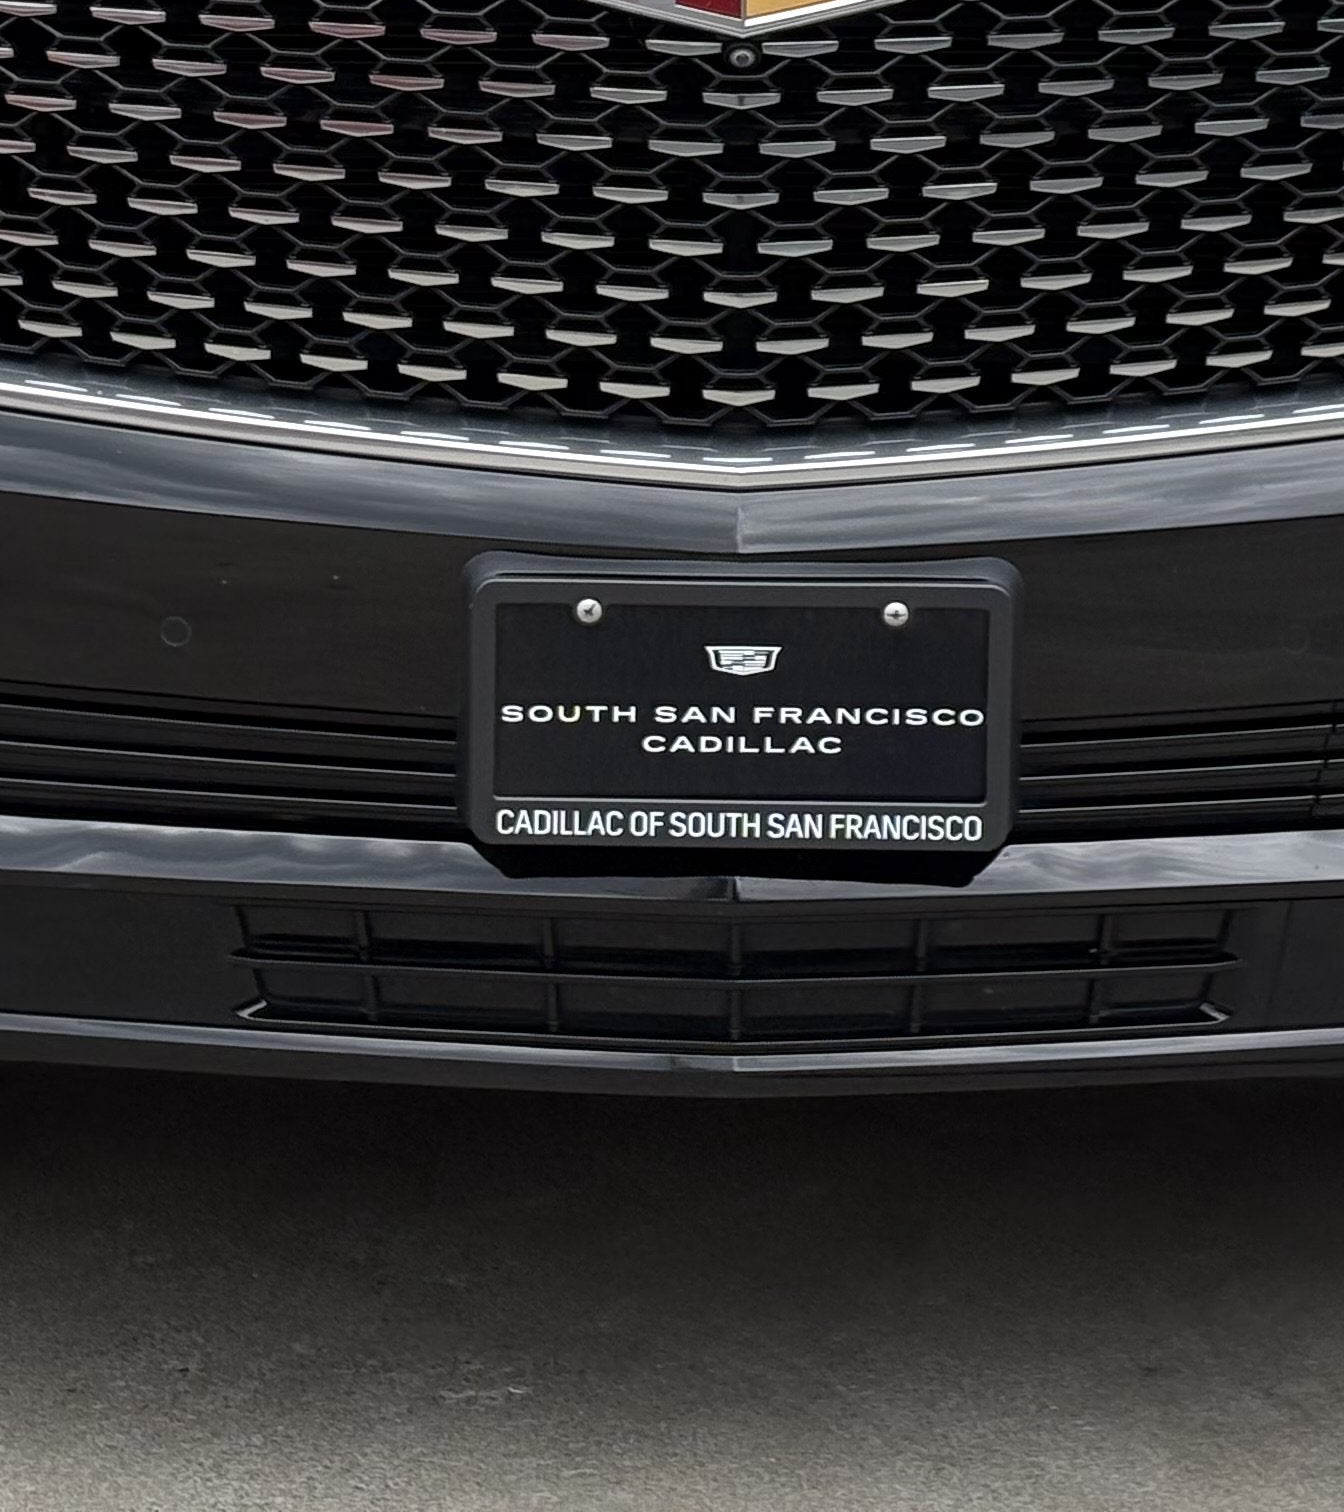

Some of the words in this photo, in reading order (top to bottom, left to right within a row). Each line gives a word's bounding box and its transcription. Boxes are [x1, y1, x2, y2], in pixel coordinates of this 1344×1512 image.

[502, 705, 636, 722] SOUTH
[655, 706, 735, 723] SAN
[754, 707, 984, 726] FRANCISCO
[642, 736, 841, 753] CADILLAC
[496, 809, 624, 836] CADILLAC
[629, 811, 664, 836] OF
[669, 812, 760, 838] SOUTH
[767, 813, 823, 839] SAN
[830, 814, 982, 841] FRANCISCO
